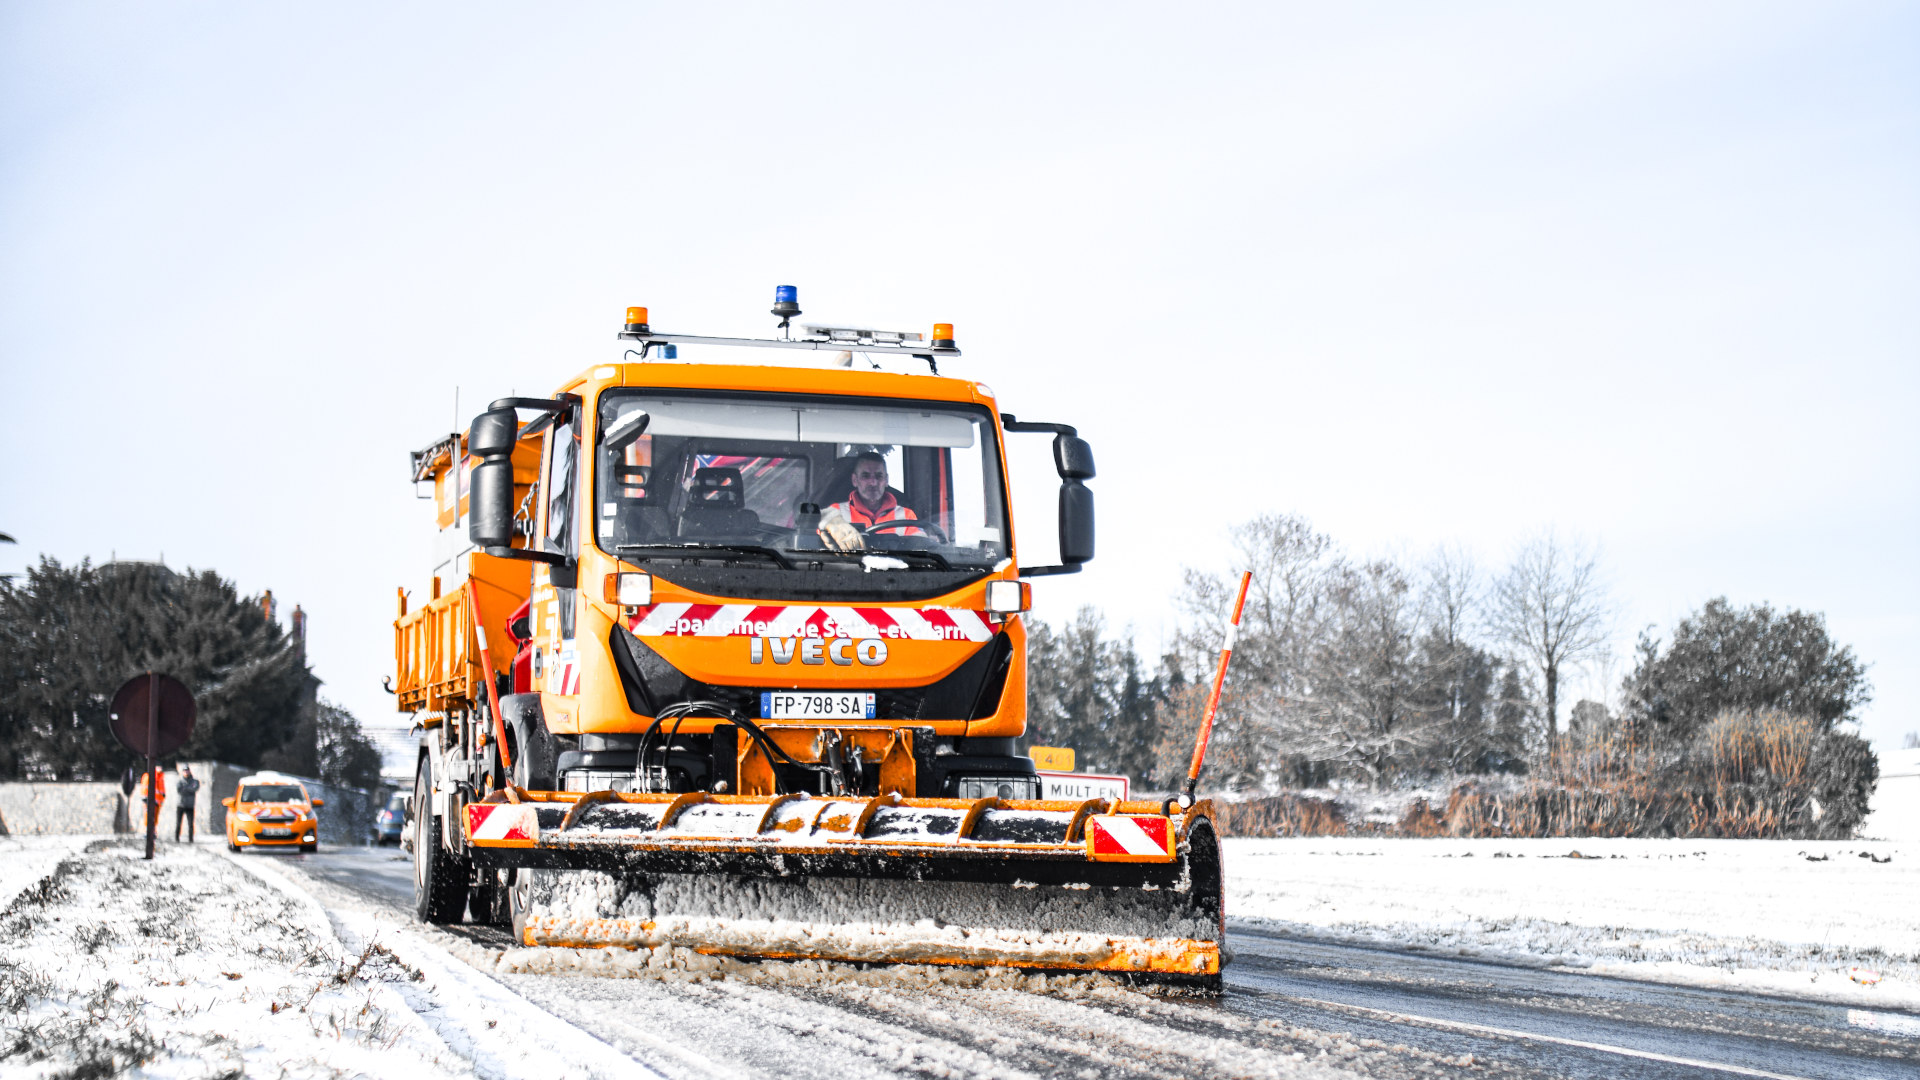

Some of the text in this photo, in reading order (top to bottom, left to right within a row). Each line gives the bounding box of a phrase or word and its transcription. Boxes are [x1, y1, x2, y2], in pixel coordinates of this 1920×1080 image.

[794, 617, 819, 638] de
[750, 636, 888, 666] IVECO
[774, 696, 861, 714] FP-798-SA
[866, 705, 875, 714] 77
